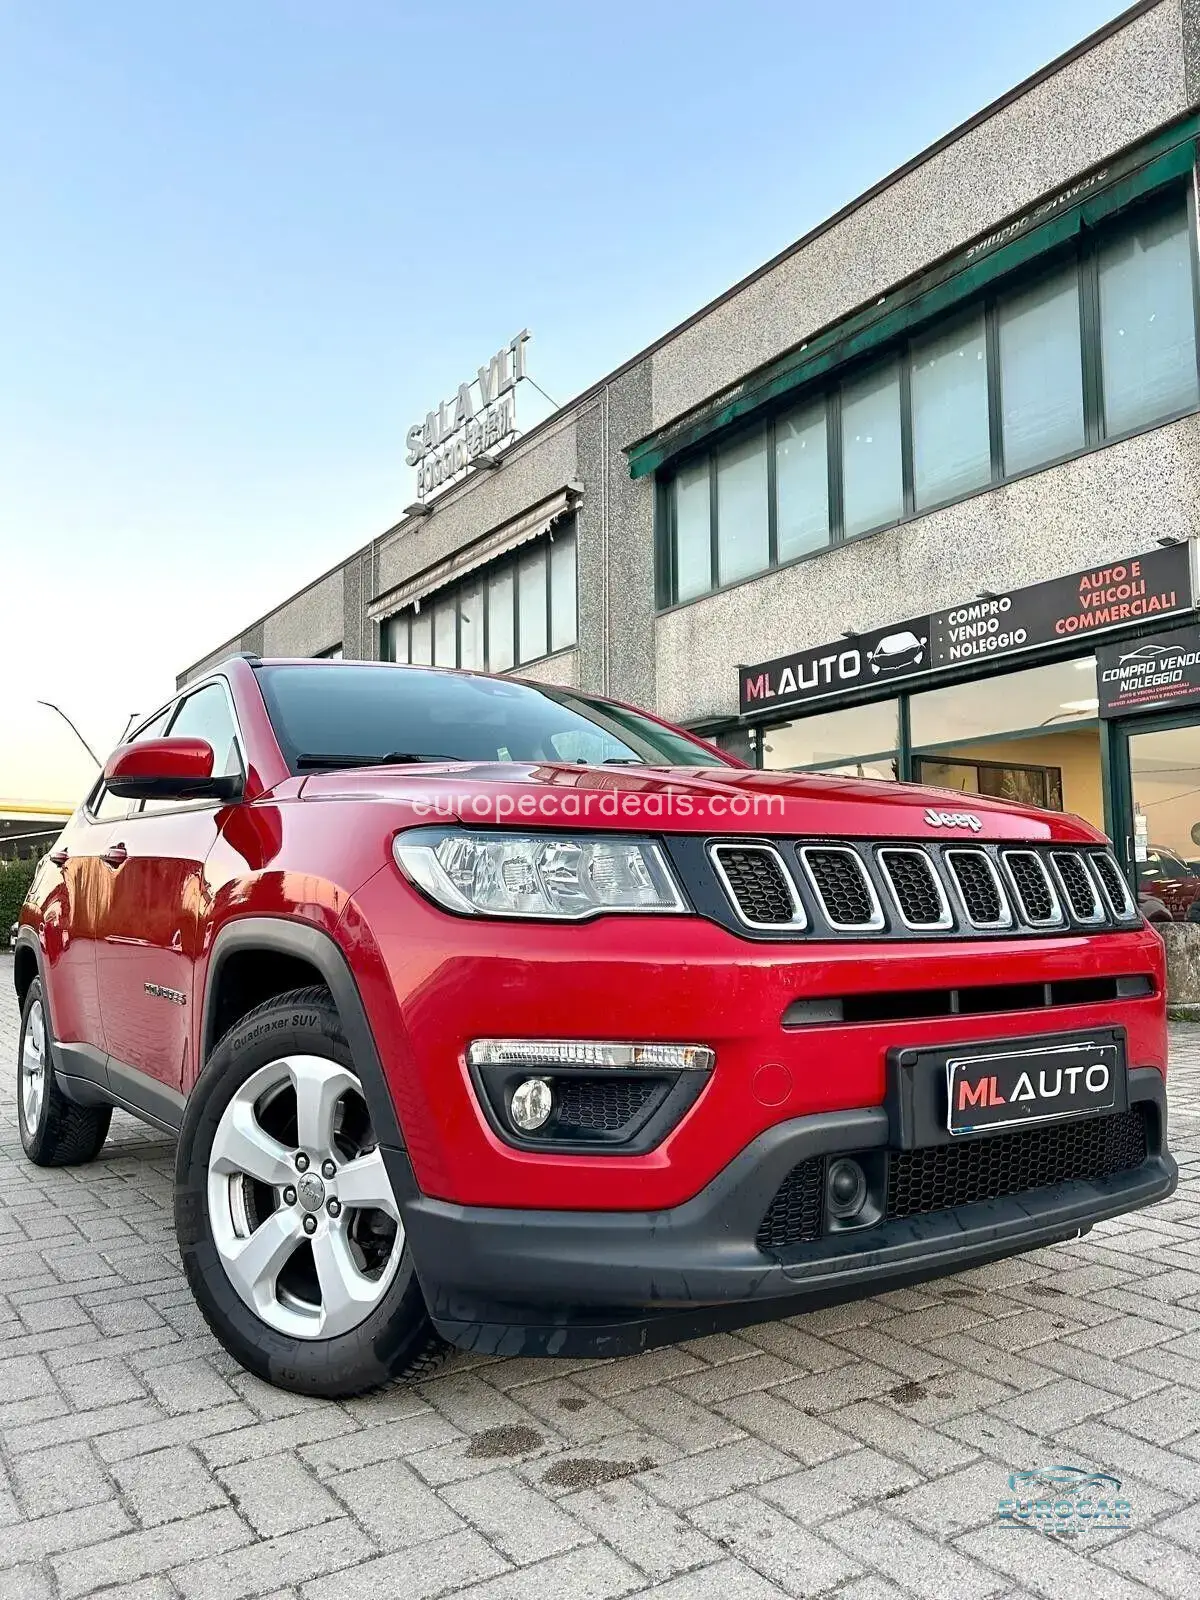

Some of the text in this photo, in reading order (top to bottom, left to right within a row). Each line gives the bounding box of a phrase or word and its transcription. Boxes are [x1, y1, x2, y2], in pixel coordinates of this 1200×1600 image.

[406, 328, 532, 467] SALA VLT
[417, 437, 468, 498] POGGIO
[1078, 561, 1141, 592] AUTO E
[1079, 579, 1146, 609] VEICOLI
[948, 597, 1012, 626] COMPRO
[1055, 591, 1176, 634] COMMERCIALI
[949, 618, 1000, 643] VENDO
[949, 628, 1028, 660] NOLEGGIO
[746, 649, 861, 702] ML AUTO
[1102, 661, 1156, 683] COMPRO
[1120, 669, 1183, 692] NOLEGGIO
[924, 808, 983, 833] Jeep
[233, 1015, 318, 1050] Quadraxer SUV
[958, 1064, 1110, 1111] ML AUTO
